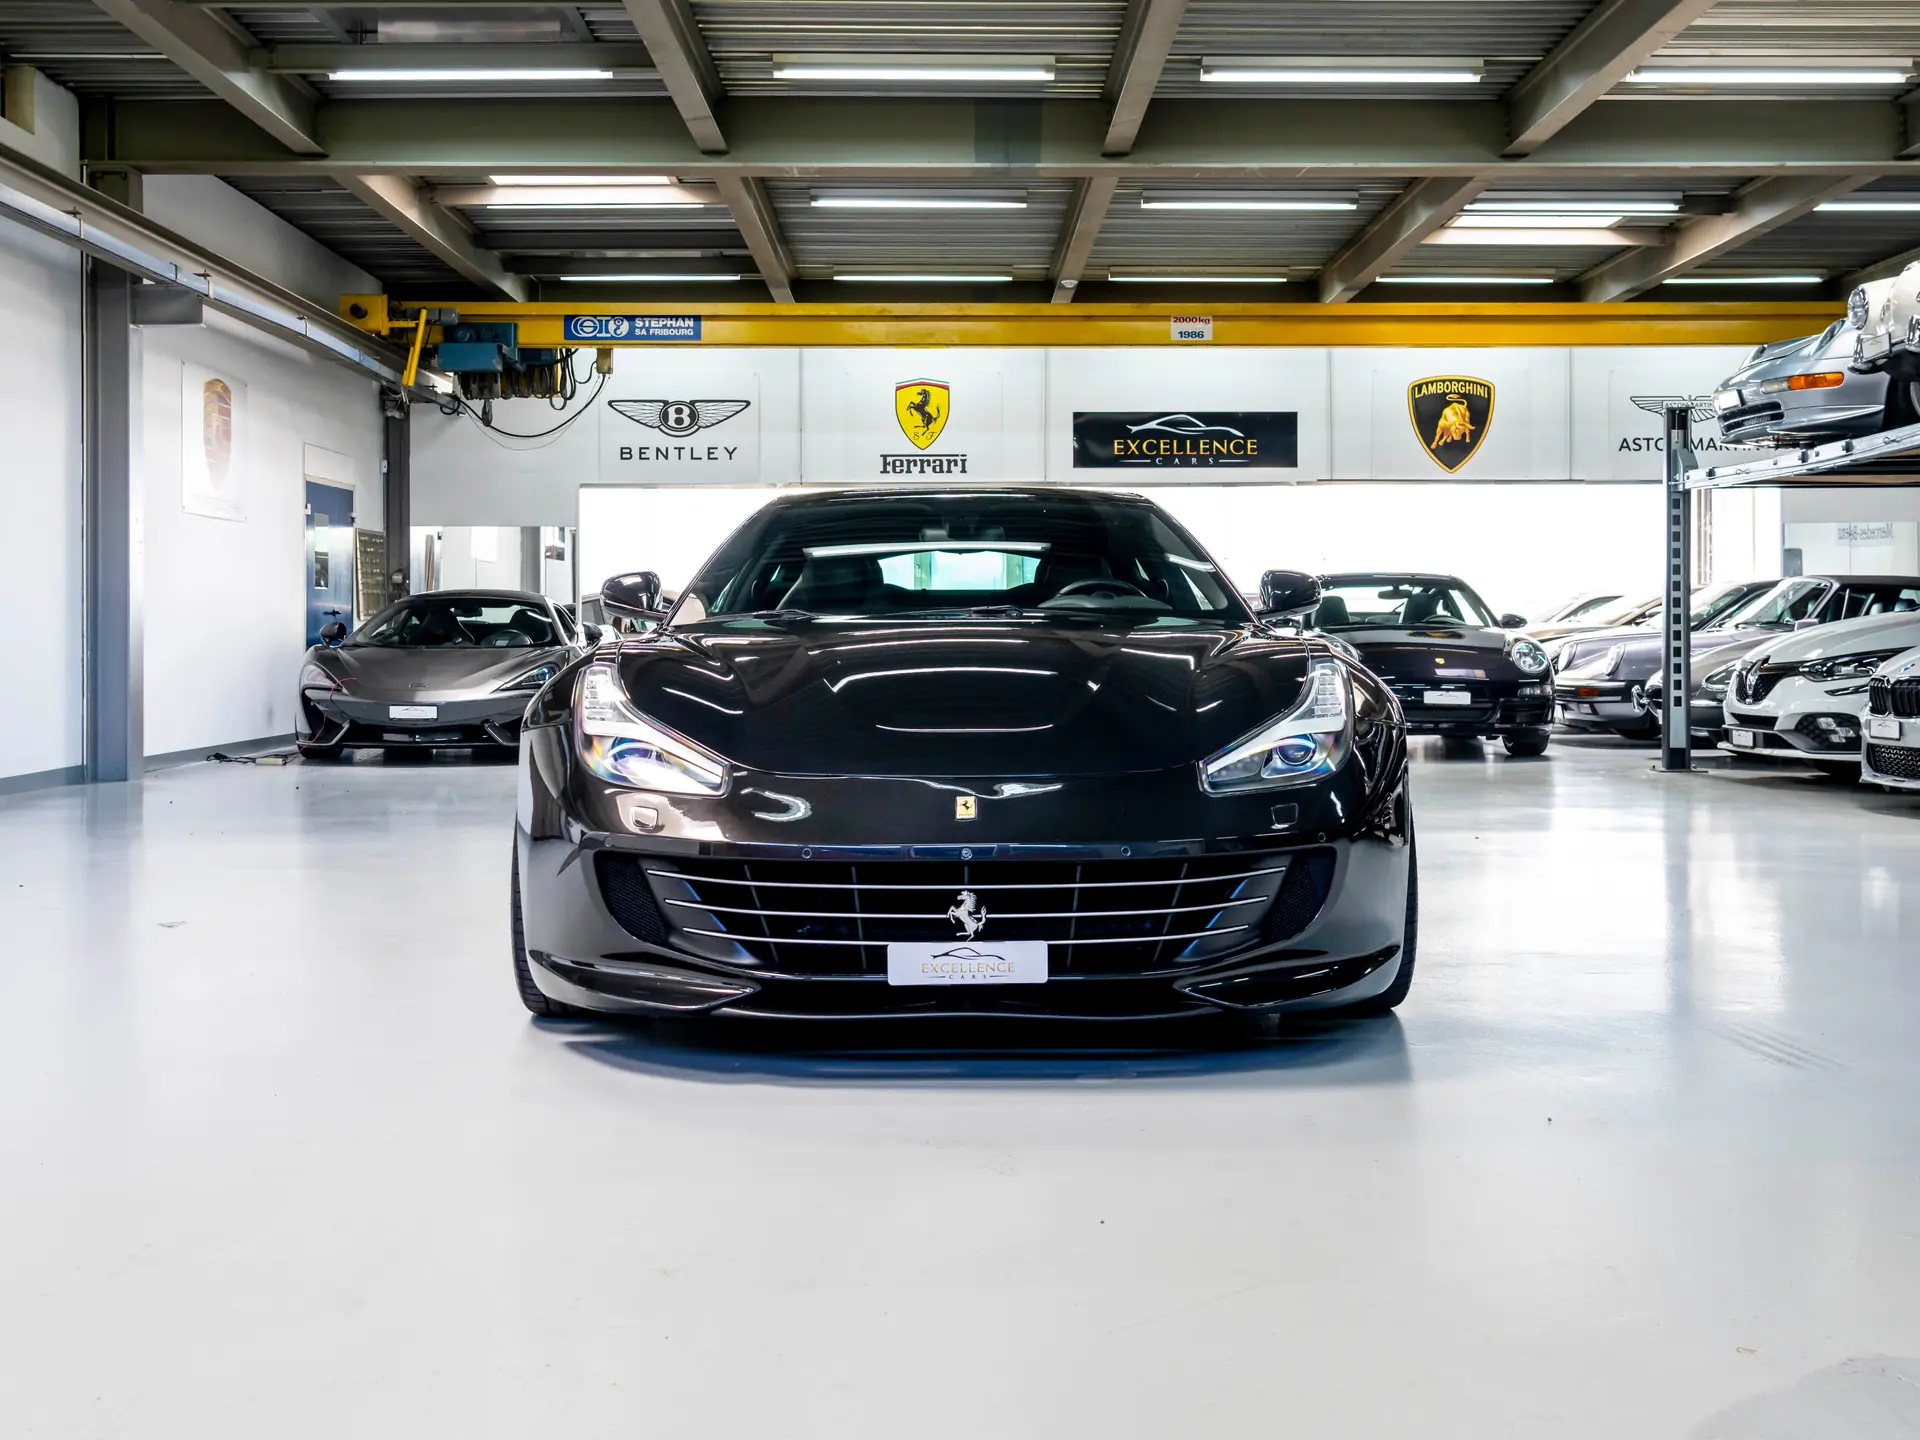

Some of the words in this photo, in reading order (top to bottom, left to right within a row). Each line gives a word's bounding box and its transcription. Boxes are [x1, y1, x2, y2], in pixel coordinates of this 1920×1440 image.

[635, 318, 694, 327] STEPHAN
[635, 328, 647, 336] SA
[649, 328, 694, 336] FRIBOURG
[1178, 330, 1205, 339] 1986
[1415, 381, 1488, 399] LAMBORGHINI
[1113, 439, 1258, 455] EXCELLENCE
[1618, 437, 1664, 452] ASTO
[620, 446, 738, 461] BENTLEY
[880, 454, 967, 474] Ferrari
[1156, 457, 1214, 465] CARS
[921, 962, 1016, 974] EXCELLENCE
